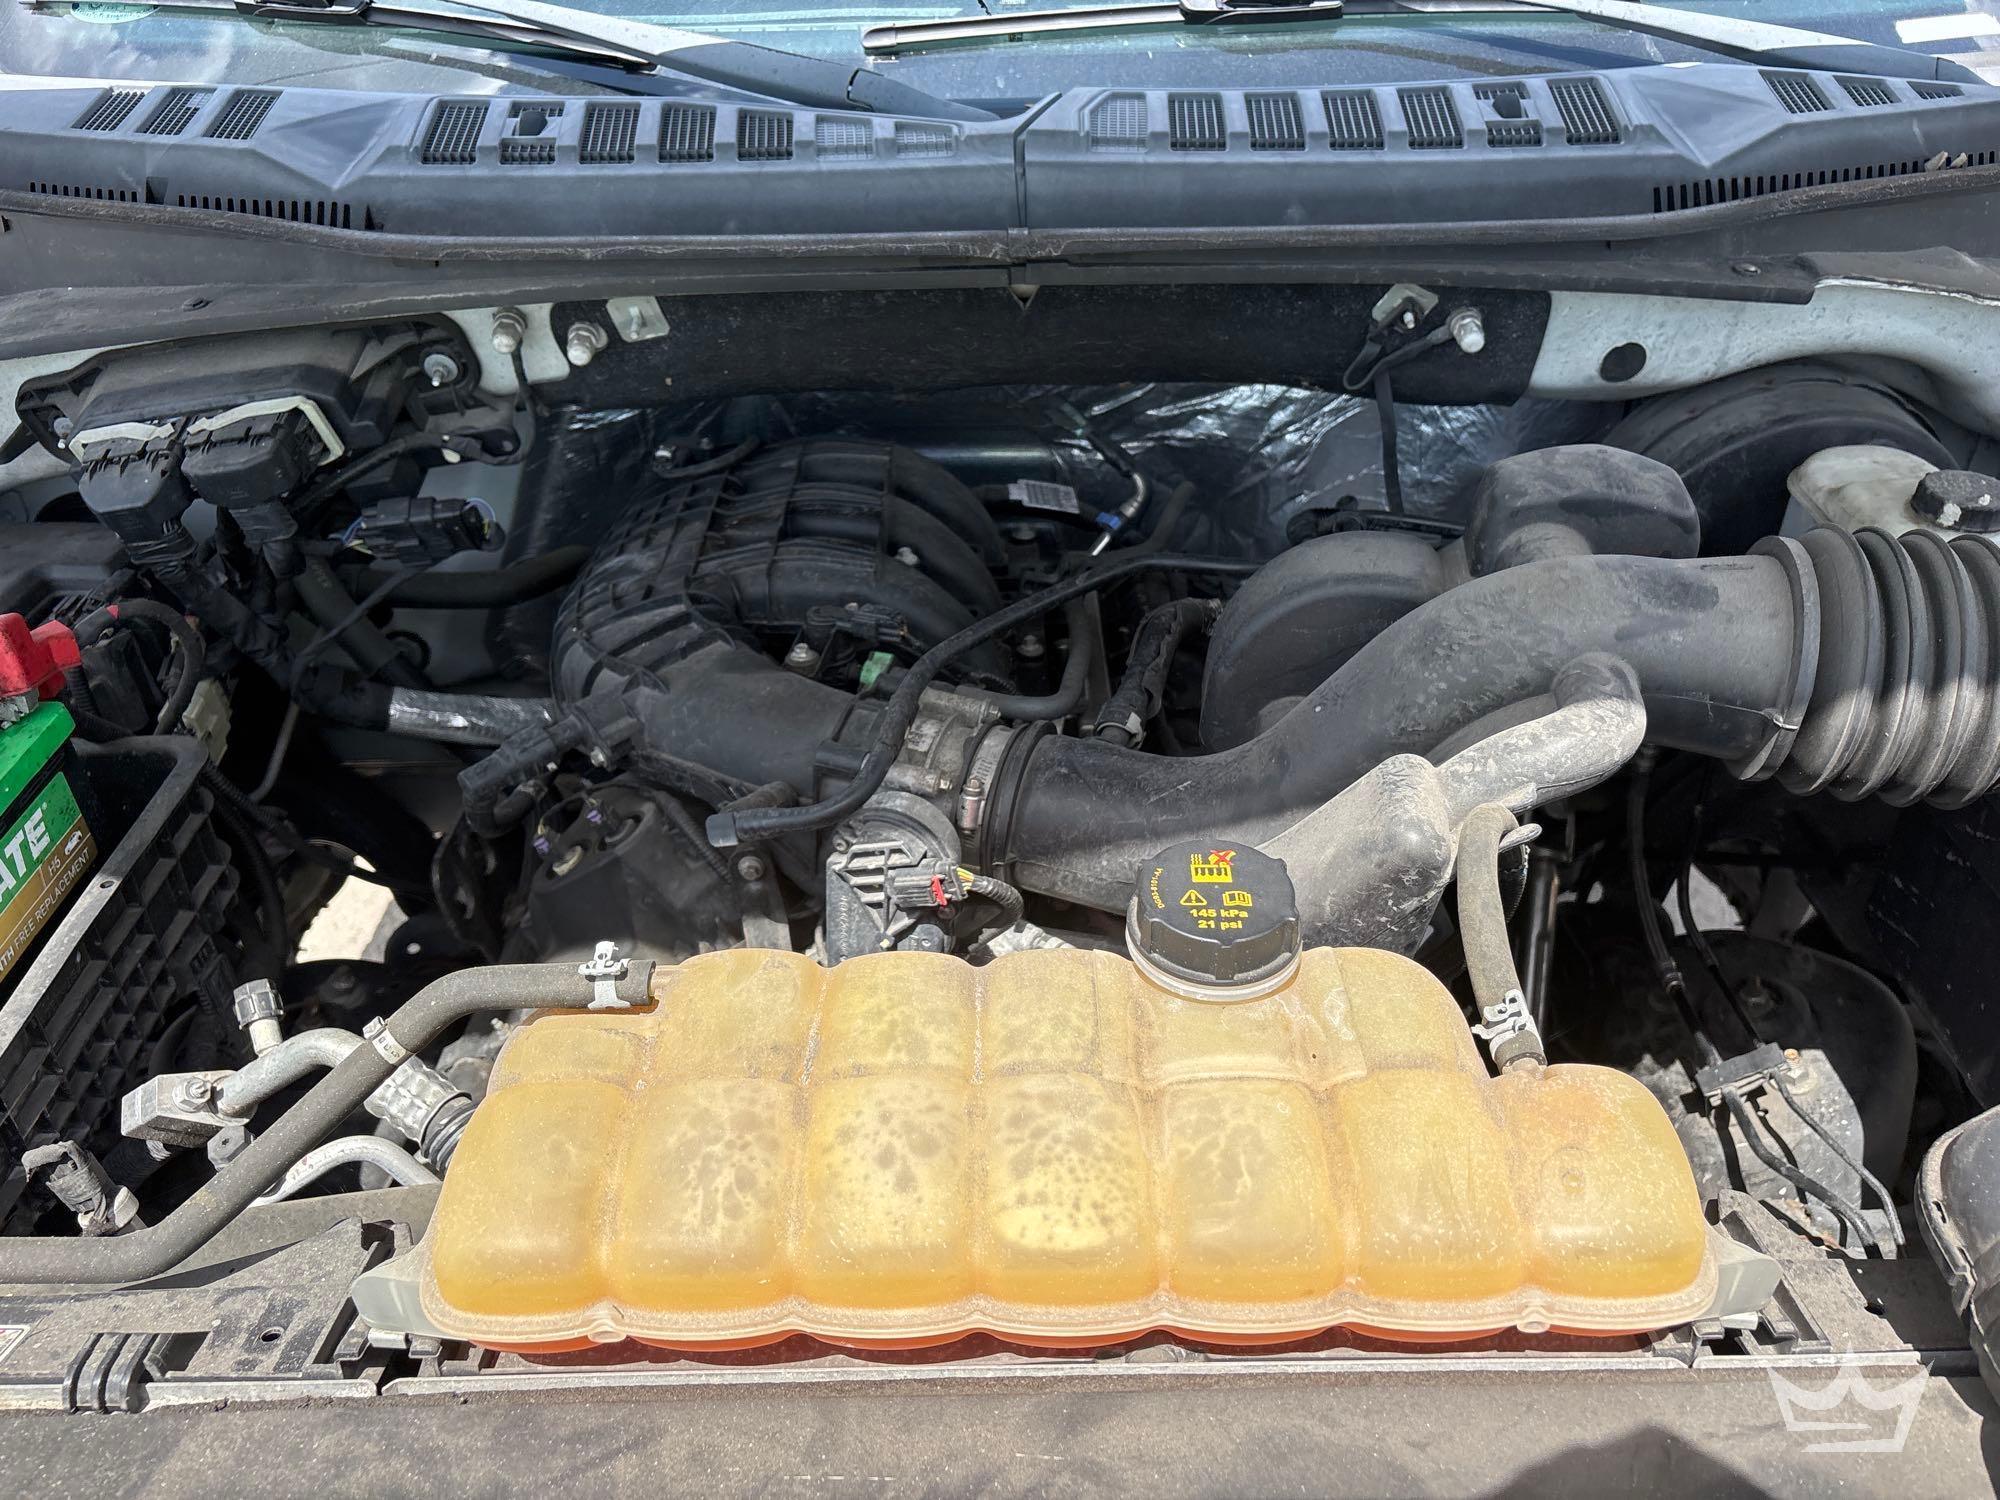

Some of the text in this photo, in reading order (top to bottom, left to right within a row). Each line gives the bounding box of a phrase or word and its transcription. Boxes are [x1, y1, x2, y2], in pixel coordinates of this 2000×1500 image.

[14, 918, 36, 950] FREE
[34, 847, 90, 923] REPLACEMENT
[1190, 908, 1248, 918] 145 kPa
[1197, 919, 1243, 931] 21 psi
